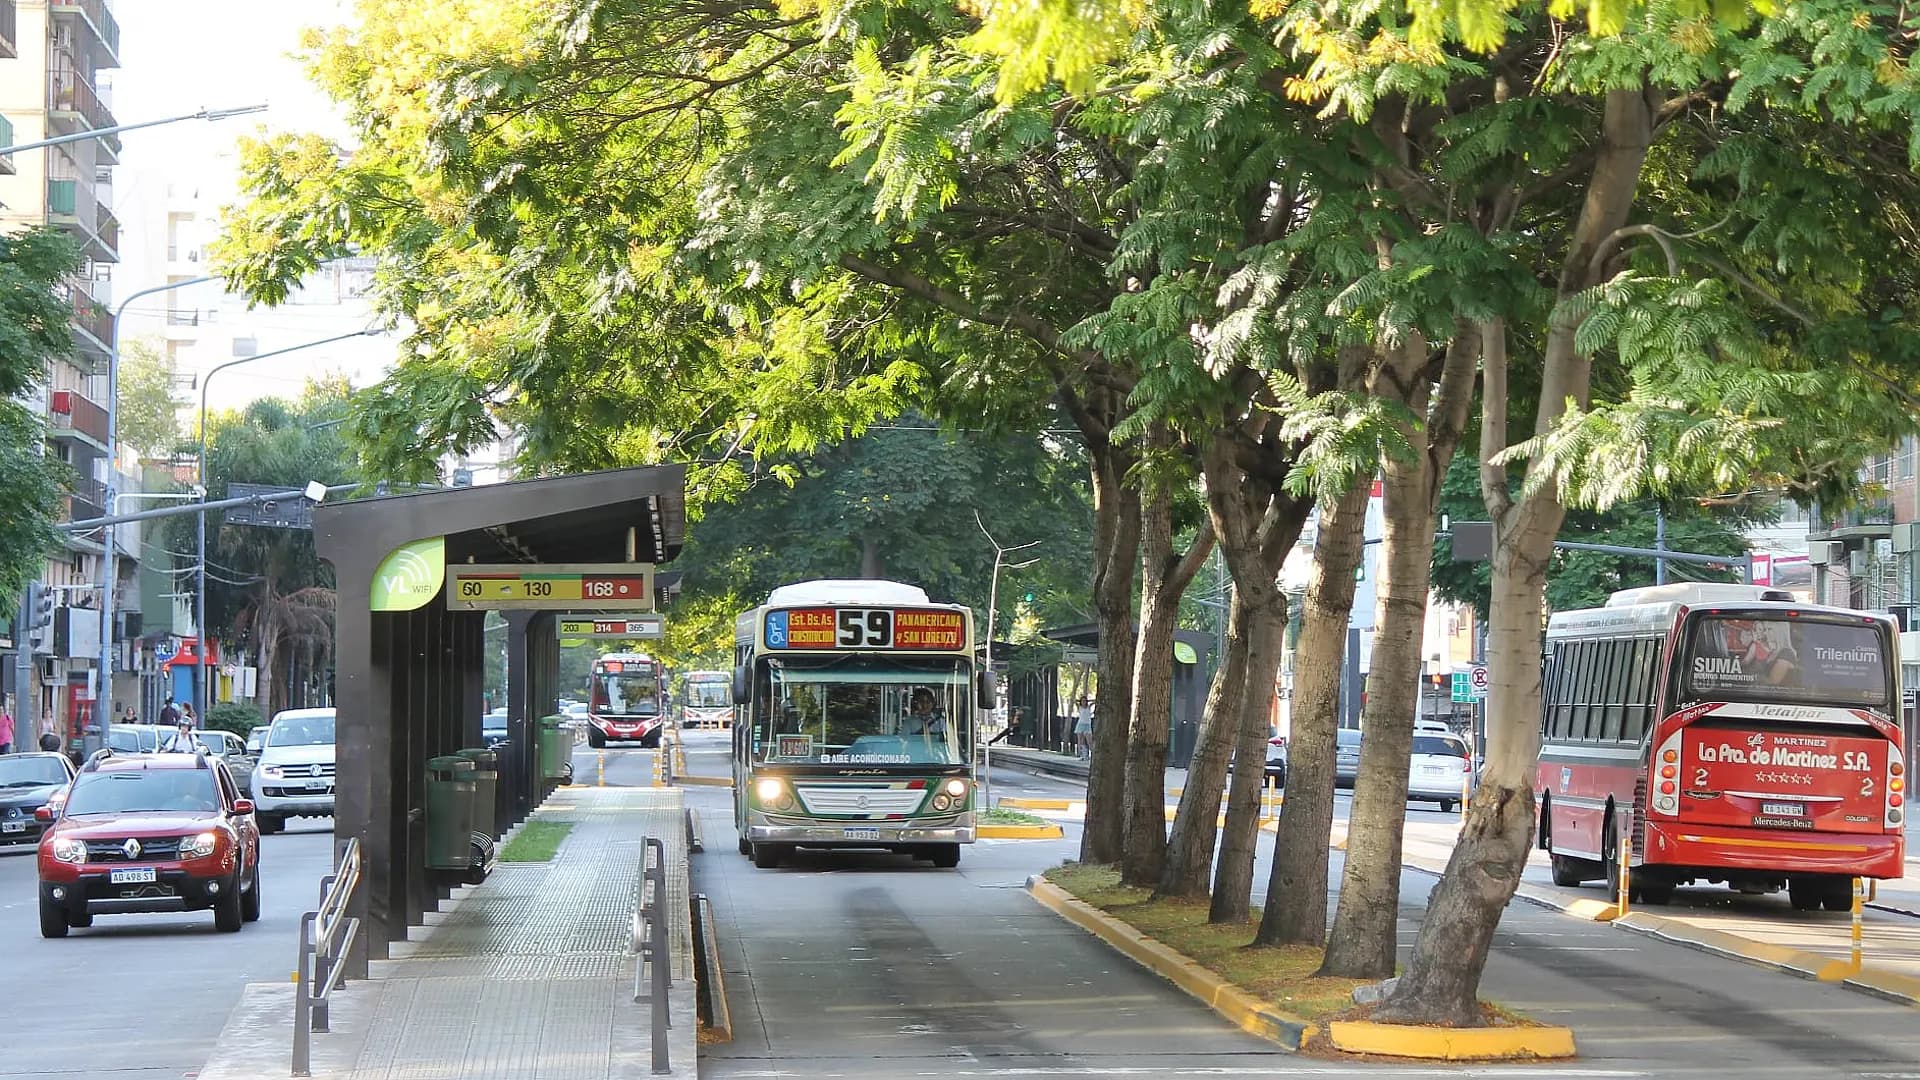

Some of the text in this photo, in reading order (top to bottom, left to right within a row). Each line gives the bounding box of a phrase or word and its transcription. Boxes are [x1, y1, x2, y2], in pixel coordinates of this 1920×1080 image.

[381, 575, 408, 593] VL
[523, 581, 551, 596] 130
[585, 582, 614, 597] 168
[789, 613, 806, 625] Est.
[897, 614, 961, 627] PANAMERICANA
[563, 623, 644, 632] 203 314 365
[839, 611, 891, 645] 59
[904, 632, 920, 643] SAN
[921, 631, 957, 644] LORENZO
[1814, 647, 1877, 663] Trilenium
[1694, 655, 1742, 674] SUMÁ
[1751, 704, 1825, 719] Metalpar
[1773, 736, 1827, 747] MARTINEZ
[832, 754, 911, 763] AIRE ACONDICIONADO
[1699, 742, 1716, 762] La
[1749, 746, 1770, 765] de
[1772, 747, 1837, 769] Martinez
[1842, 751, 1871, 771] S.A.
[1695, 768, 1708, 786] 2
[1861, 777, 1874, 796] 2
[1753, 816, 1812, 828] Mercedes-Benz
[126, 872, 142, 881] 498
